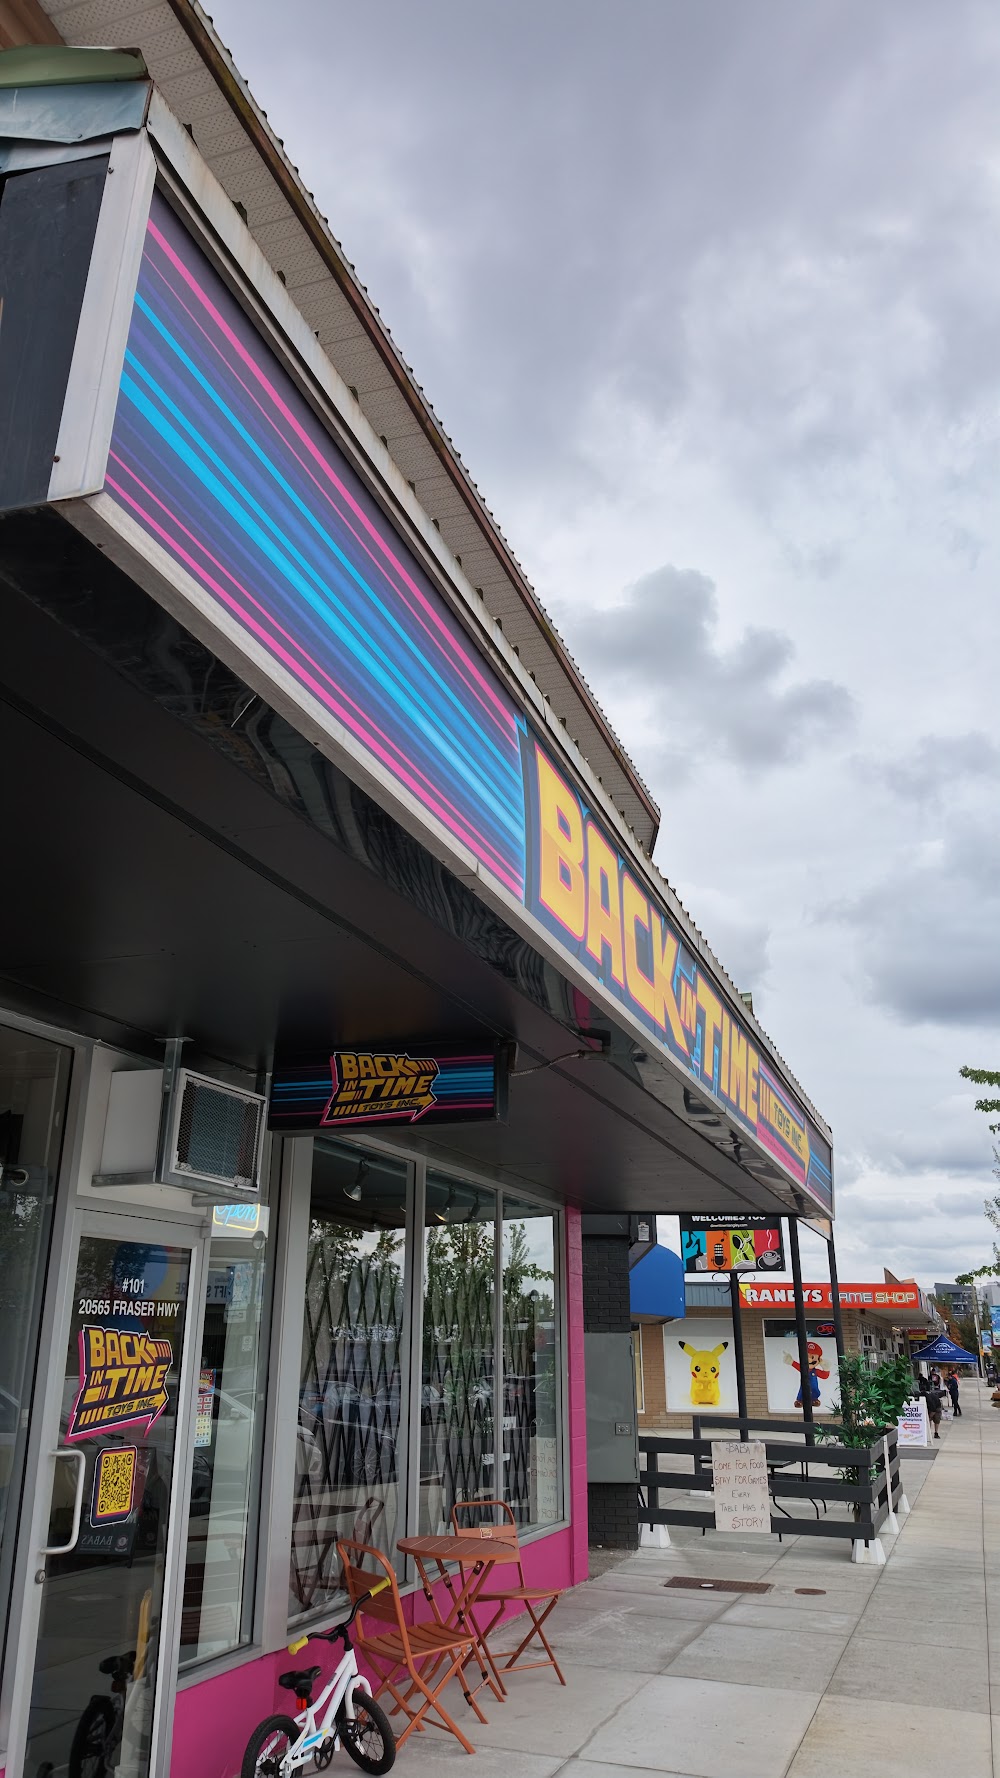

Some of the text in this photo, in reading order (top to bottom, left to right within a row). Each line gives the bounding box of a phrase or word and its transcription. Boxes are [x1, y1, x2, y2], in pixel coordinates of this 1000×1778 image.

[535, 741, 690, 1055] BACK
[679, 975, 698, 1037] IN
[696, 969, 760, 1125] TIME
[340, 1054, 418, 1079] BACK
[343, 1075, 434, 1100] IN TIME
[362, 1100, 396, 1112] TOYS
[773, 1102, 791, 1138] TOYS
[122, 1277, 146, 1295] #101
[875, 1292, 916, 1304] SHOP
[78, 1299, 180, 1318] 20565 FRASER HWY
[89, 1328, 156, 1368] BACK
[90, 1364, 168, 1400] IN TIME
[106, 1400, 135, 1417] TOYS
[725, 1443, 750, 1454] BABA
[713, 1459, 764, 1470] COME FOR FOOD
[714, 1474, 767, 1485] STAY FOR GAMES
[731, 1489, 751, 1498] EVERY
[719, 1503, 766, 1512] TABLE HAS A
[731, 1516, 764, 1530] STORY
